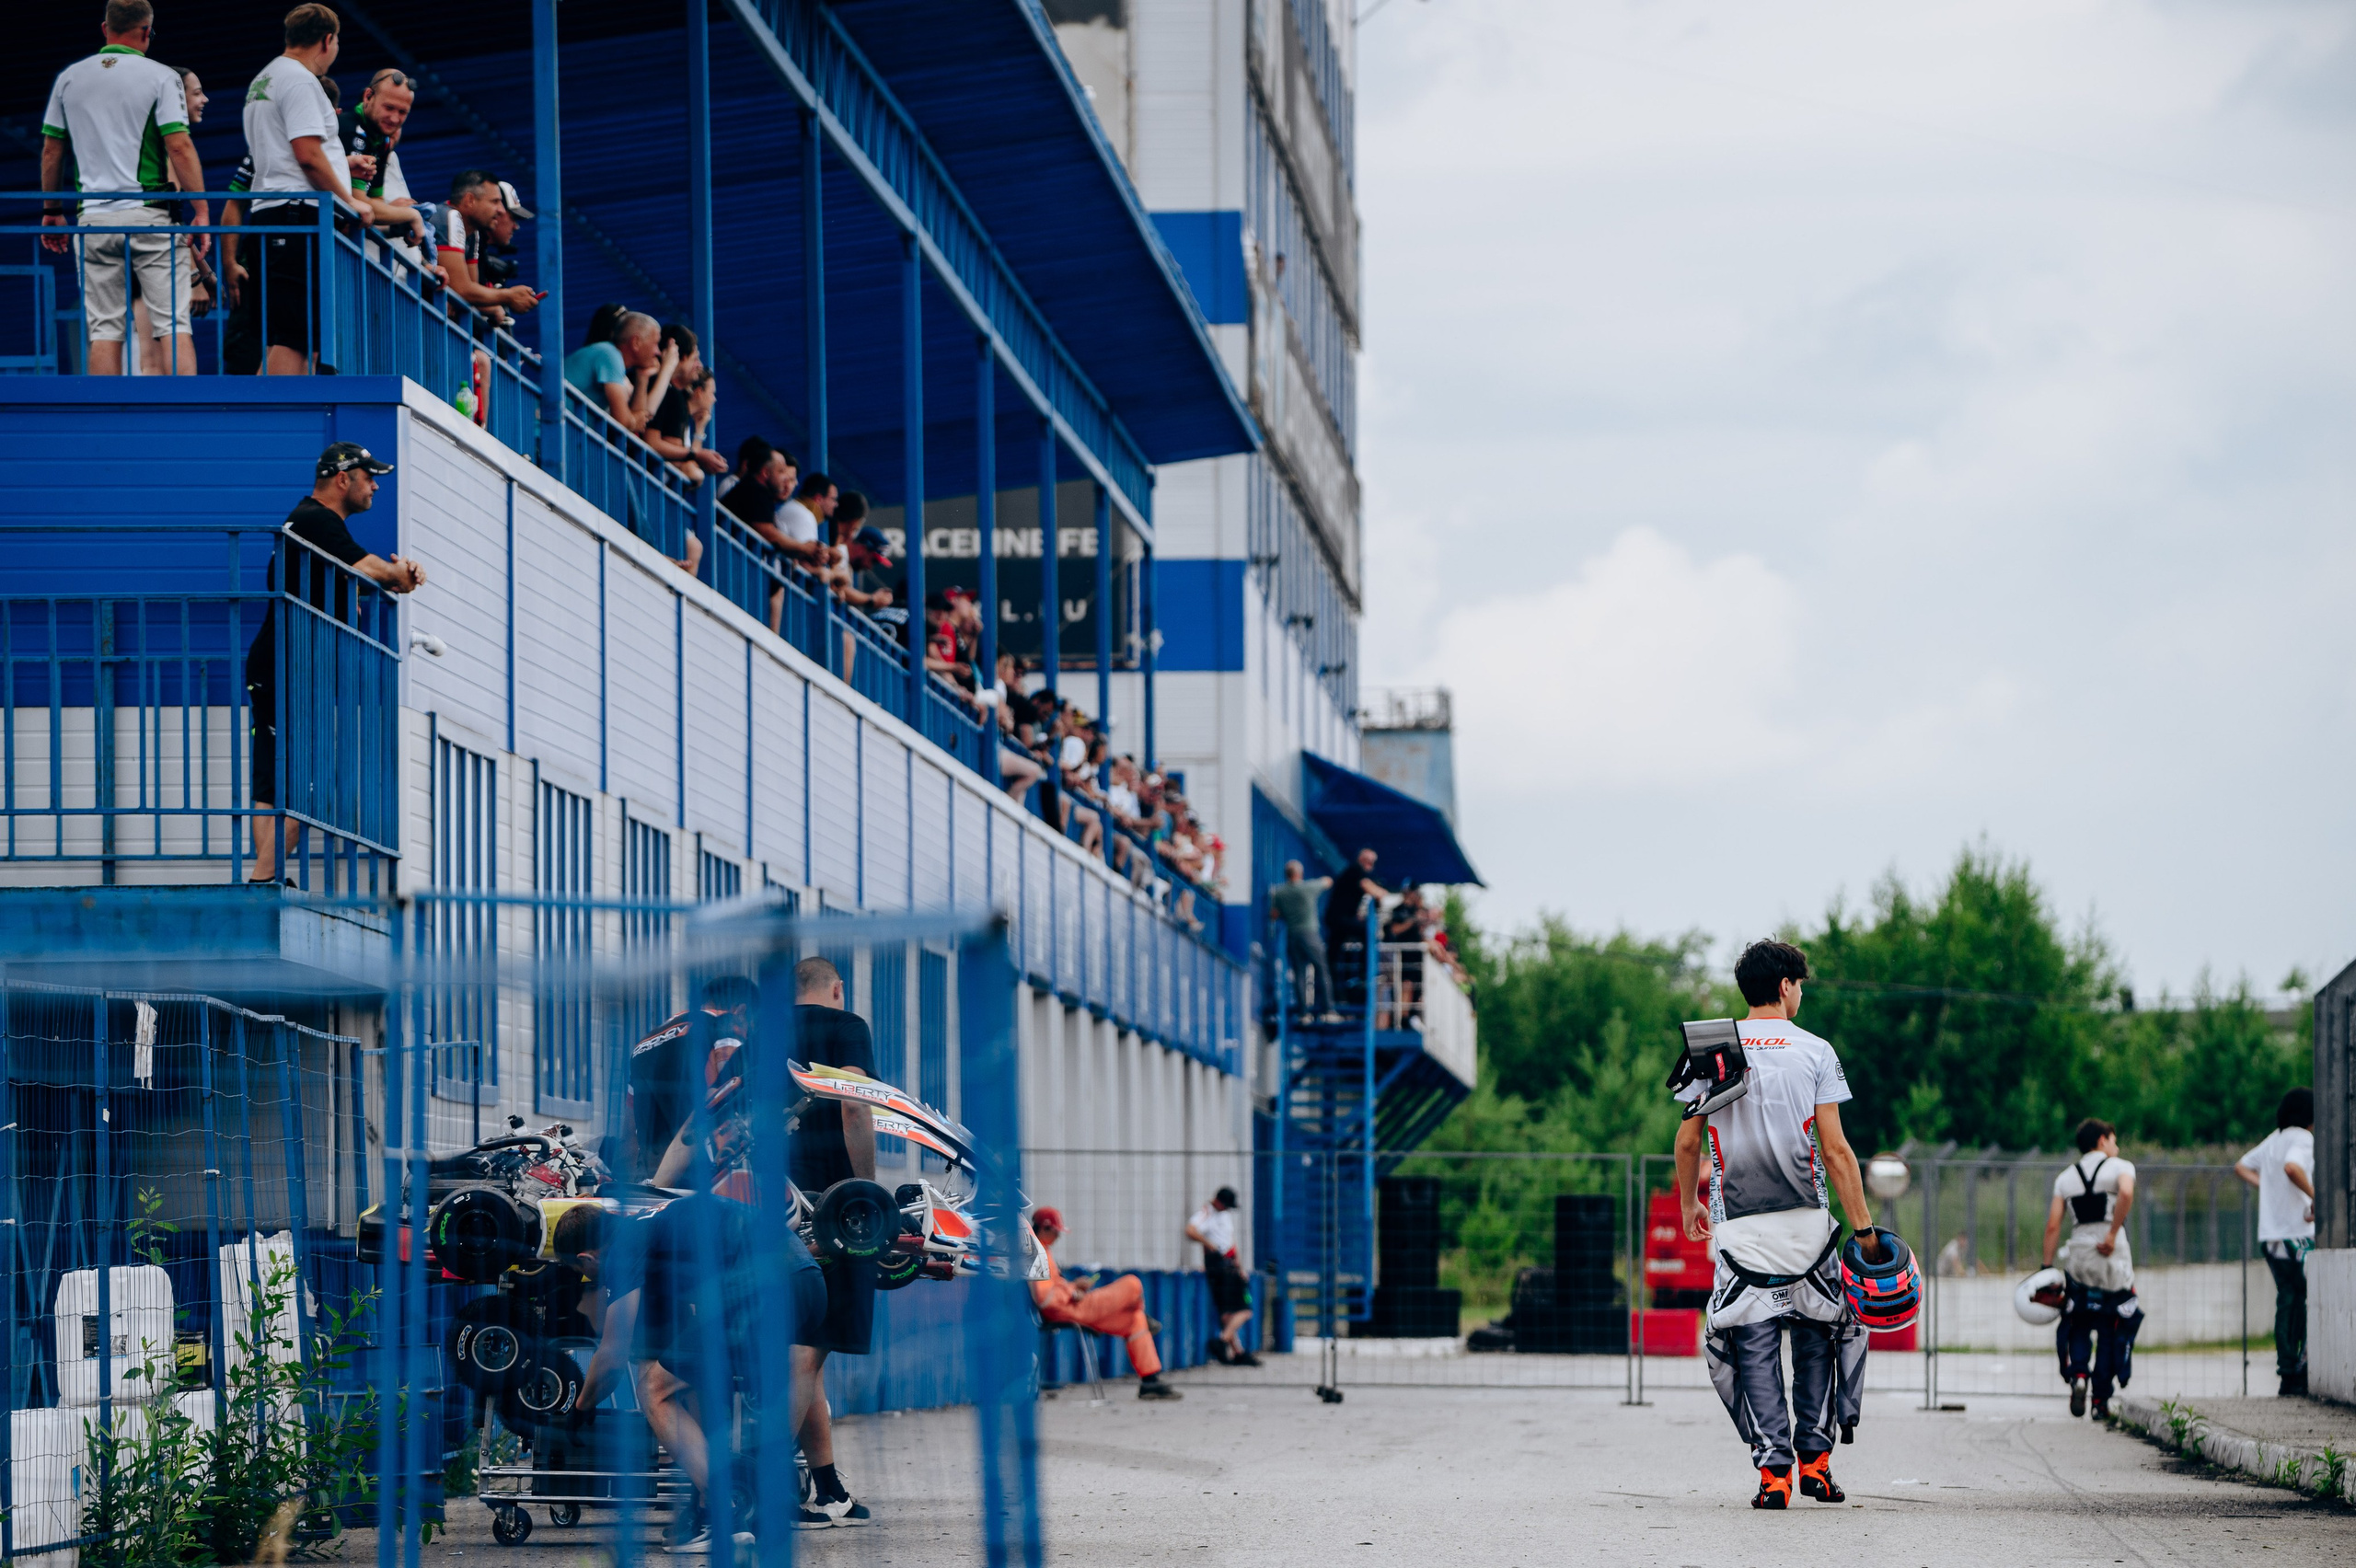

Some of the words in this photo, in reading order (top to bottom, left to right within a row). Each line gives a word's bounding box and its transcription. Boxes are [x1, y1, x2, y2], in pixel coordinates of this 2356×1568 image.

[633, 1025, 688, 1055] ORONOV
[1739, 1037, 1792, 1047] OKOL
[872, 1118, 911, 1133] ERTY
[439, 1212, 452, 1245] VEGA
[848, 1246, 879, 1256] VEGA
[890, 1263, 918, 1280] VEGA
[458, 1326, 472, 1359] VEGA
[560, 1381, 576, 1412] VEGA
